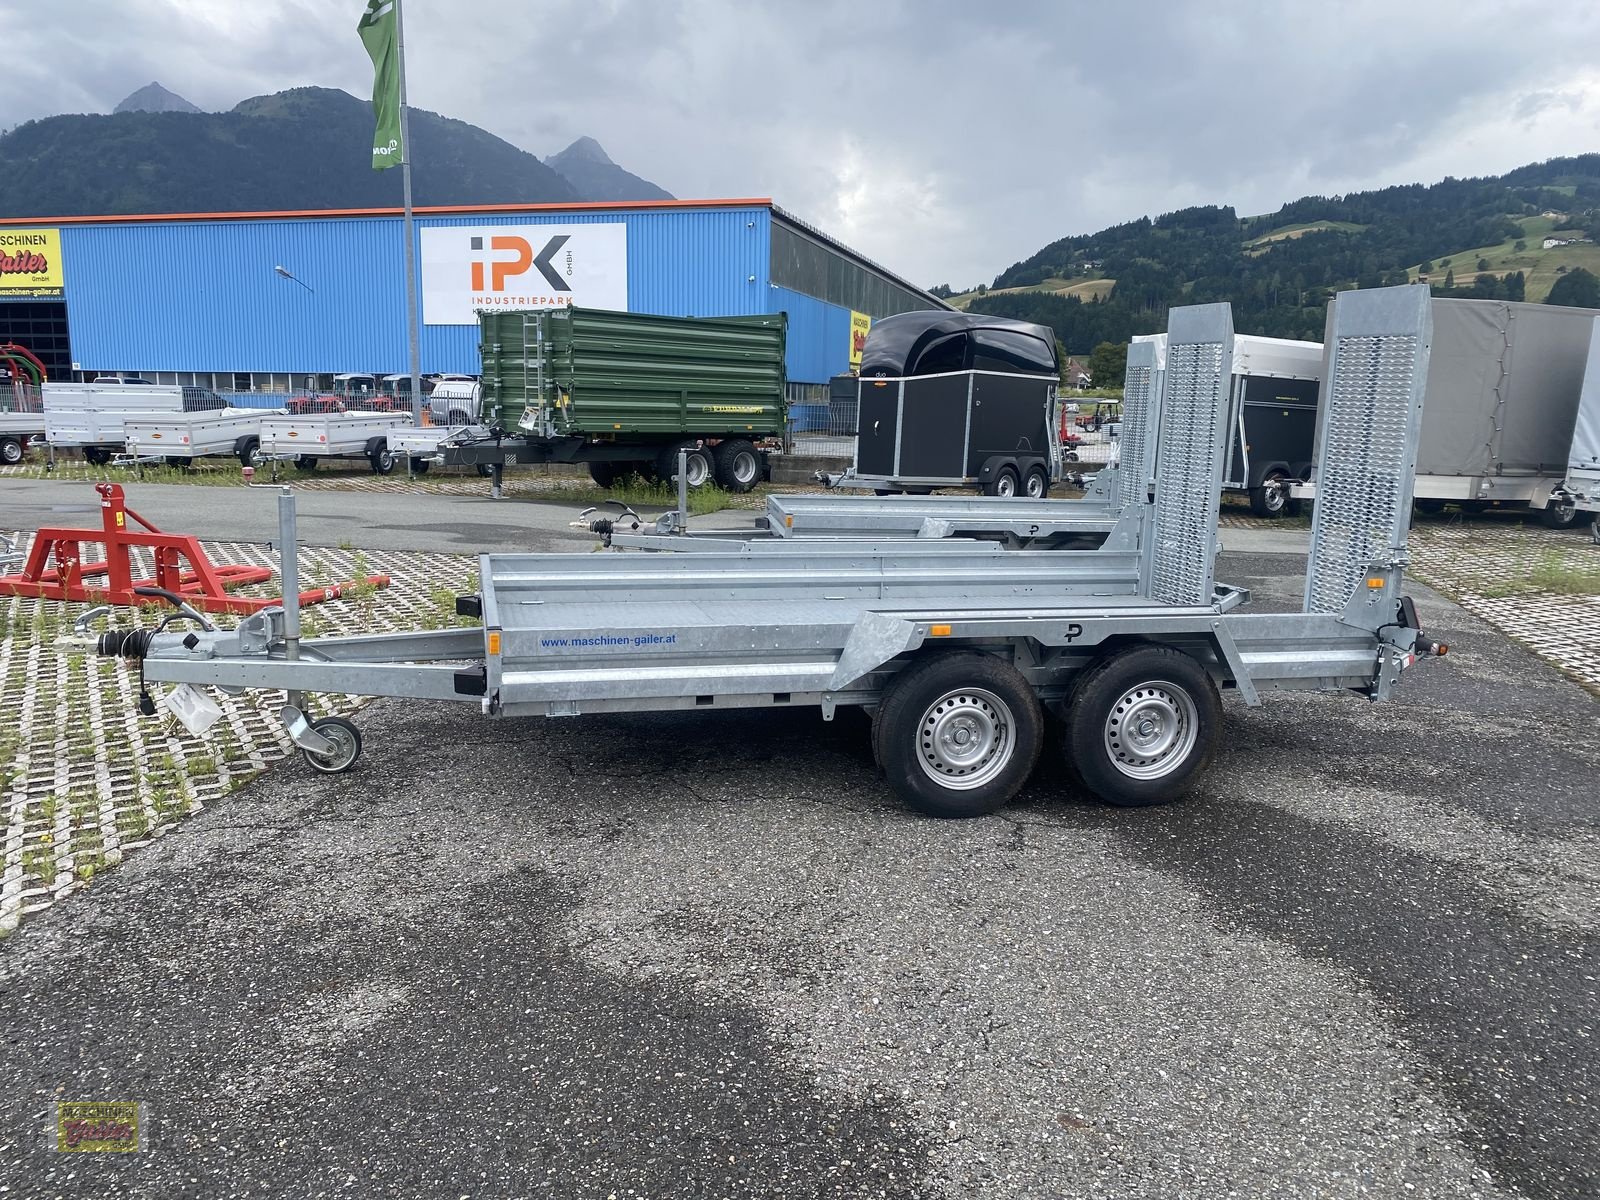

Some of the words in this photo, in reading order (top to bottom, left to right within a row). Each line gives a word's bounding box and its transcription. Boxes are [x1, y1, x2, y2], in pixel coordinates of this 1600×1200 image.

[0, 288, 61, 297] aschinen-gailer.at
[472, 296, 573, 305] INDUSTRIEPARK
[541, 634, 677, 647] www.maschinen-gailer.at
